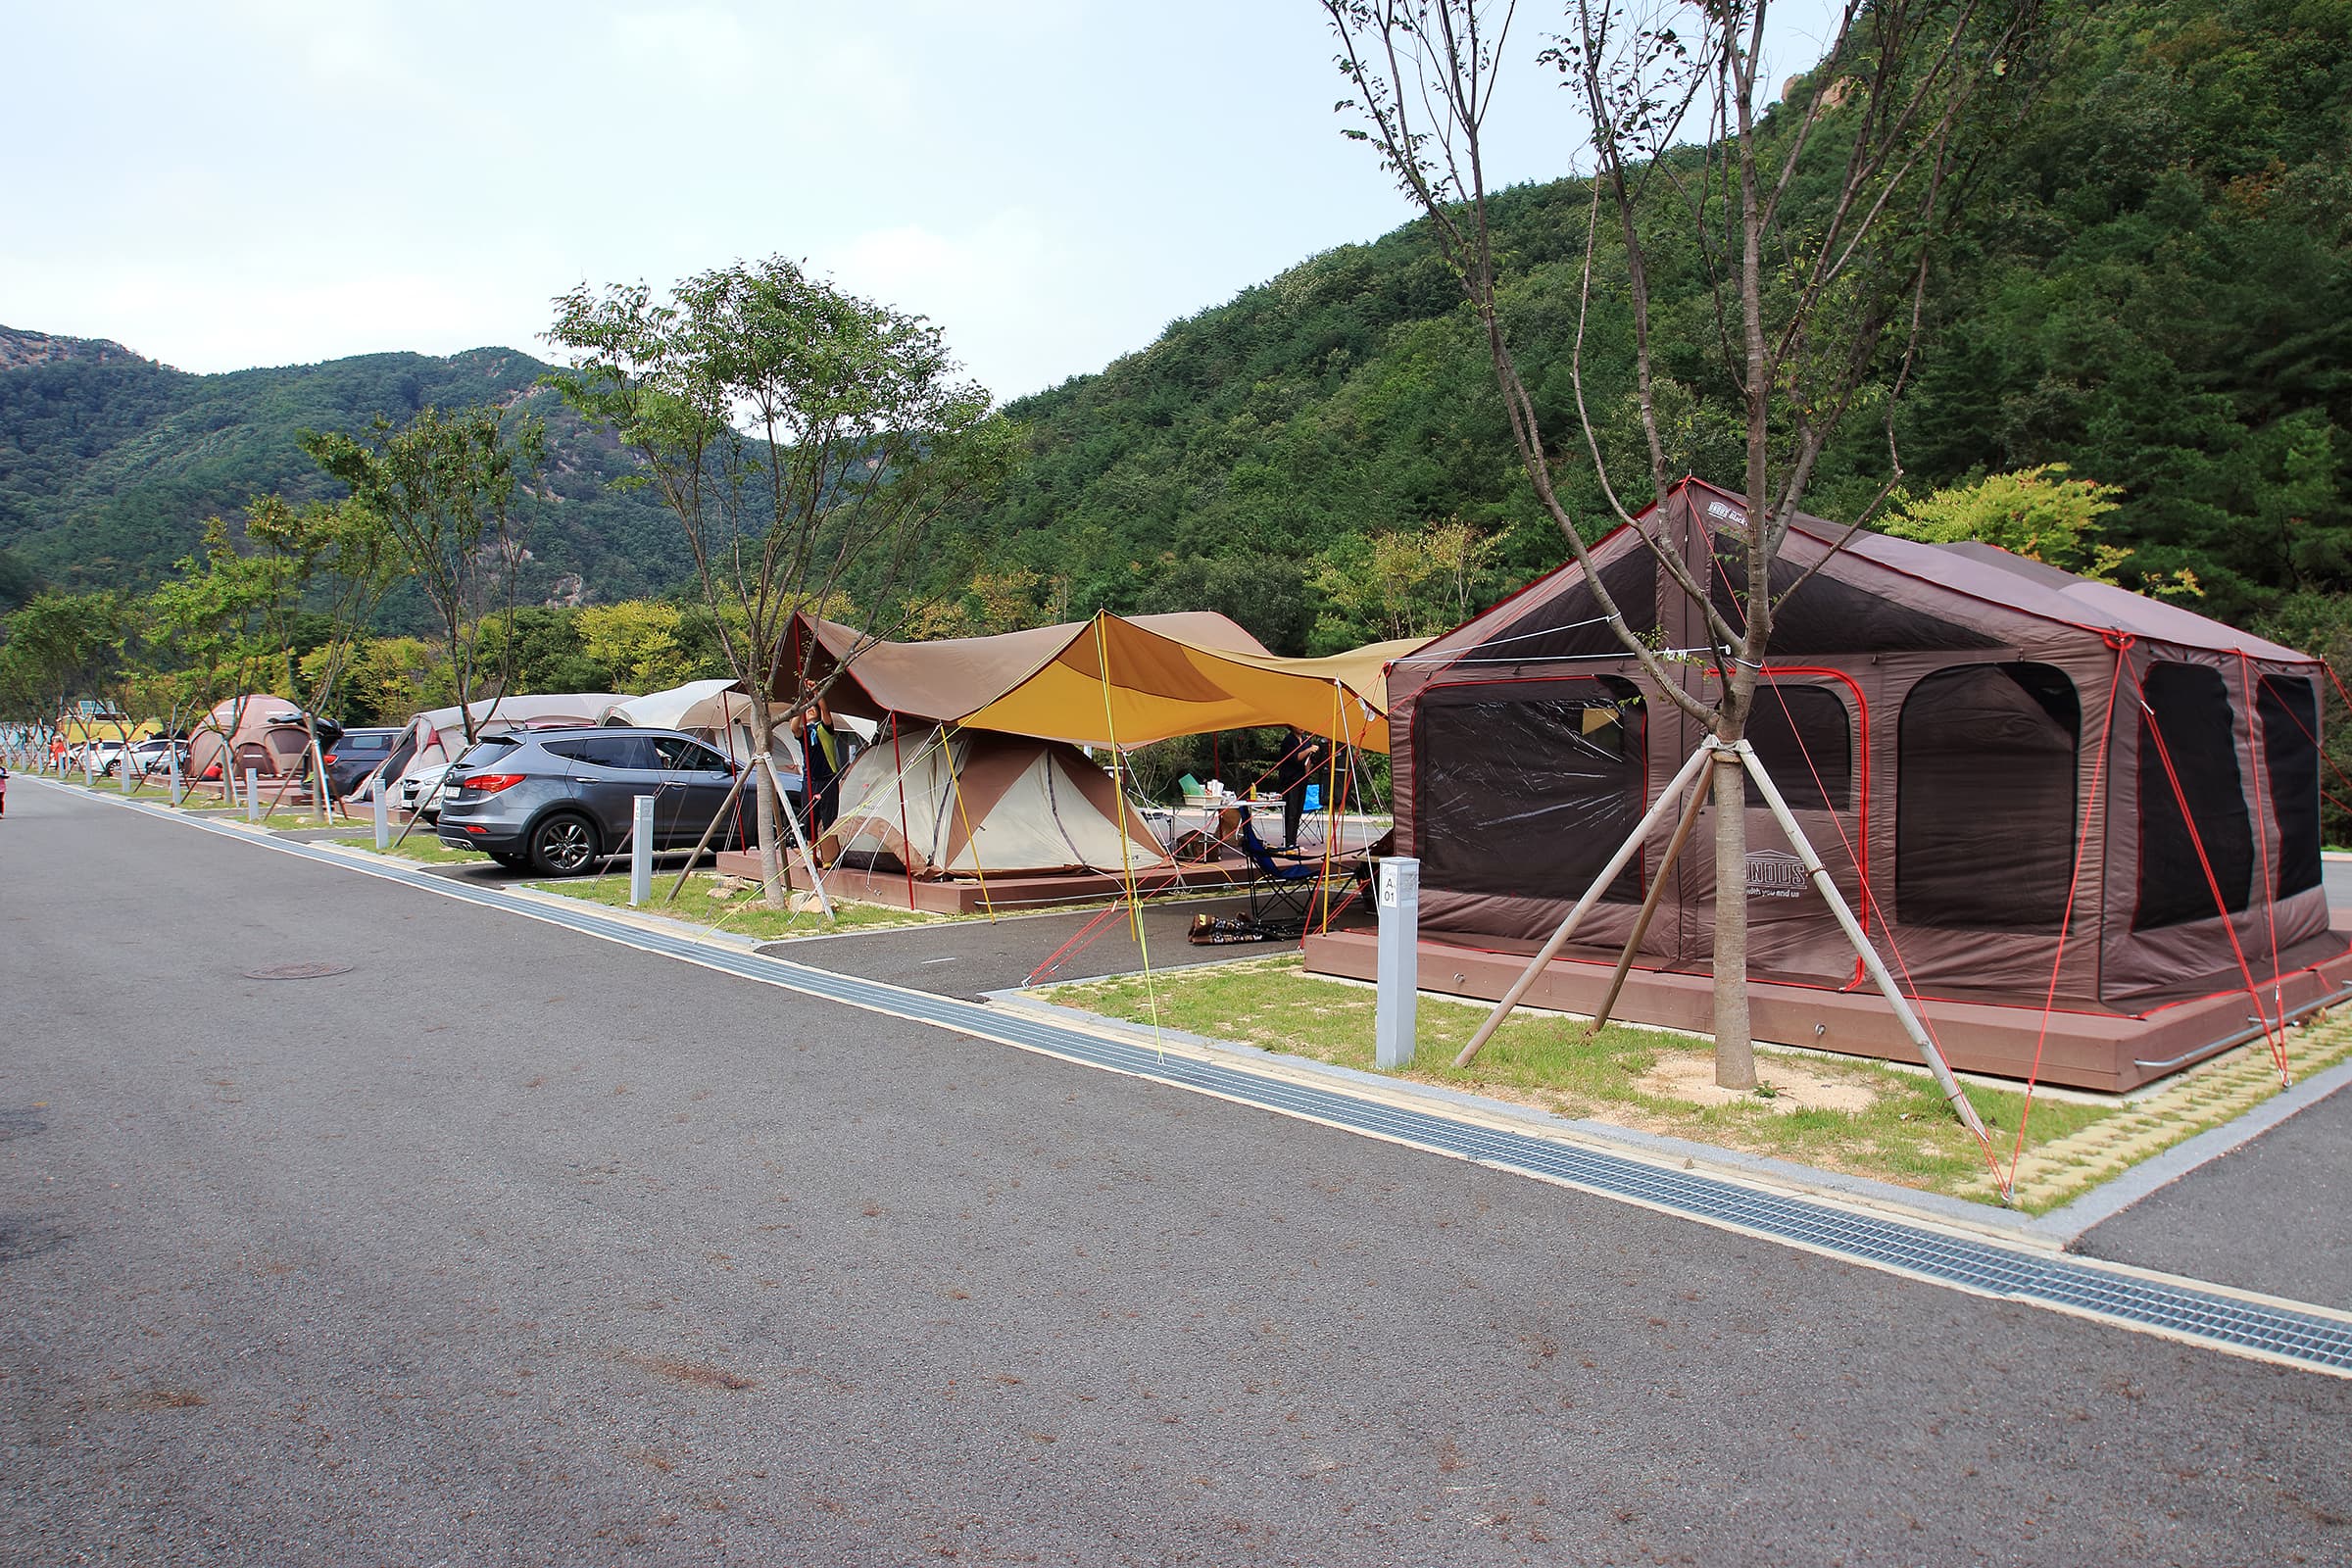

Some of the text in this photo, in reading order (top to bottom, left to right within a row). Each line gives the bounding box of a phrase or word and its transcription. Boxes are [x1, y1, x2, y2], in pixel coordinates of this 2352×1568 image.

[1386, 878, 1394, 888] A
[1384, 891, 1395, 902] 01
[1776, 889, 1789, 898] and
